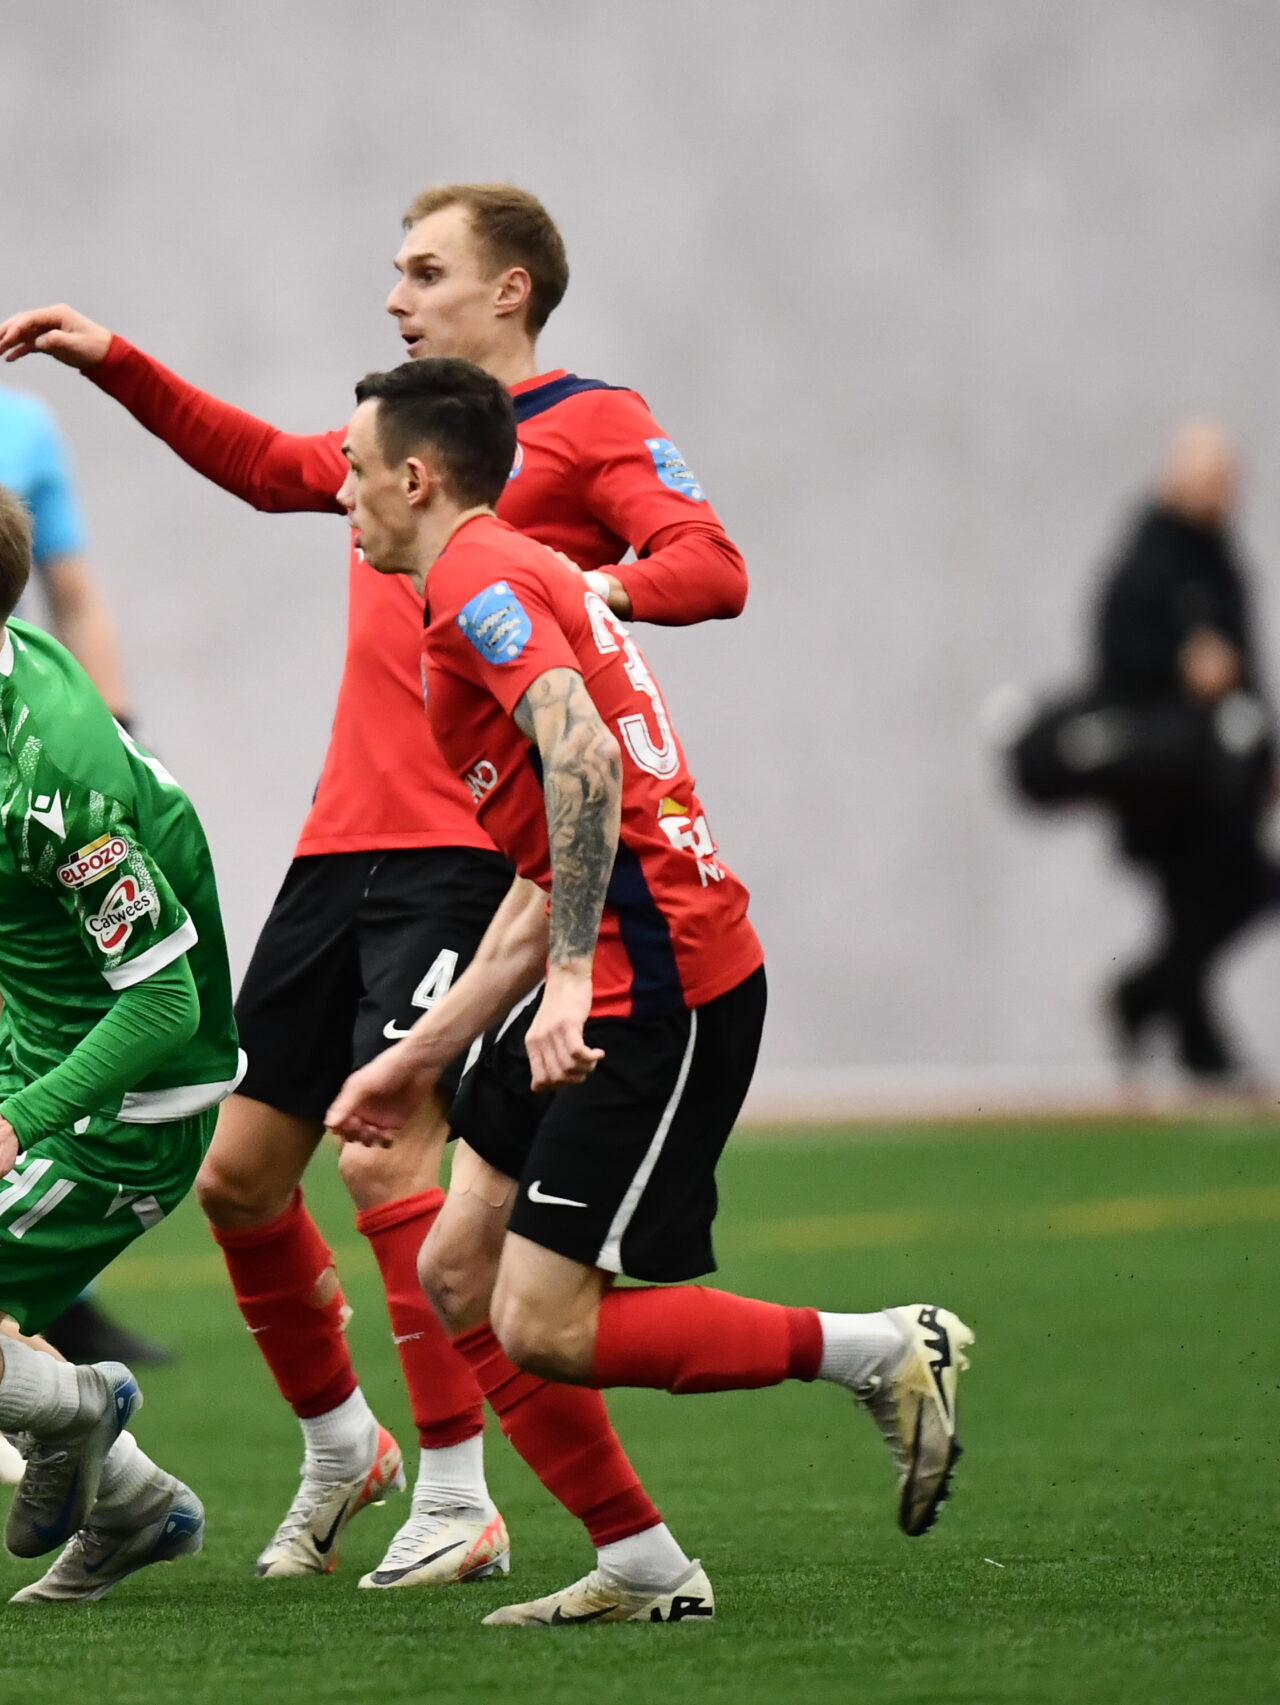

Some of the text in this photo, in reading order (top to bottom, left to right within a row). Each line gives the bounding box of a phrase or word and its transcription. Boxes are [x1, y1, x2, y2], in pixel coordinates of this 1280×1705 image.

[584, 591, 680, 780] 3
[89, 895, 151, 933] Catwees
[411, 948, 460, 1010] 4
